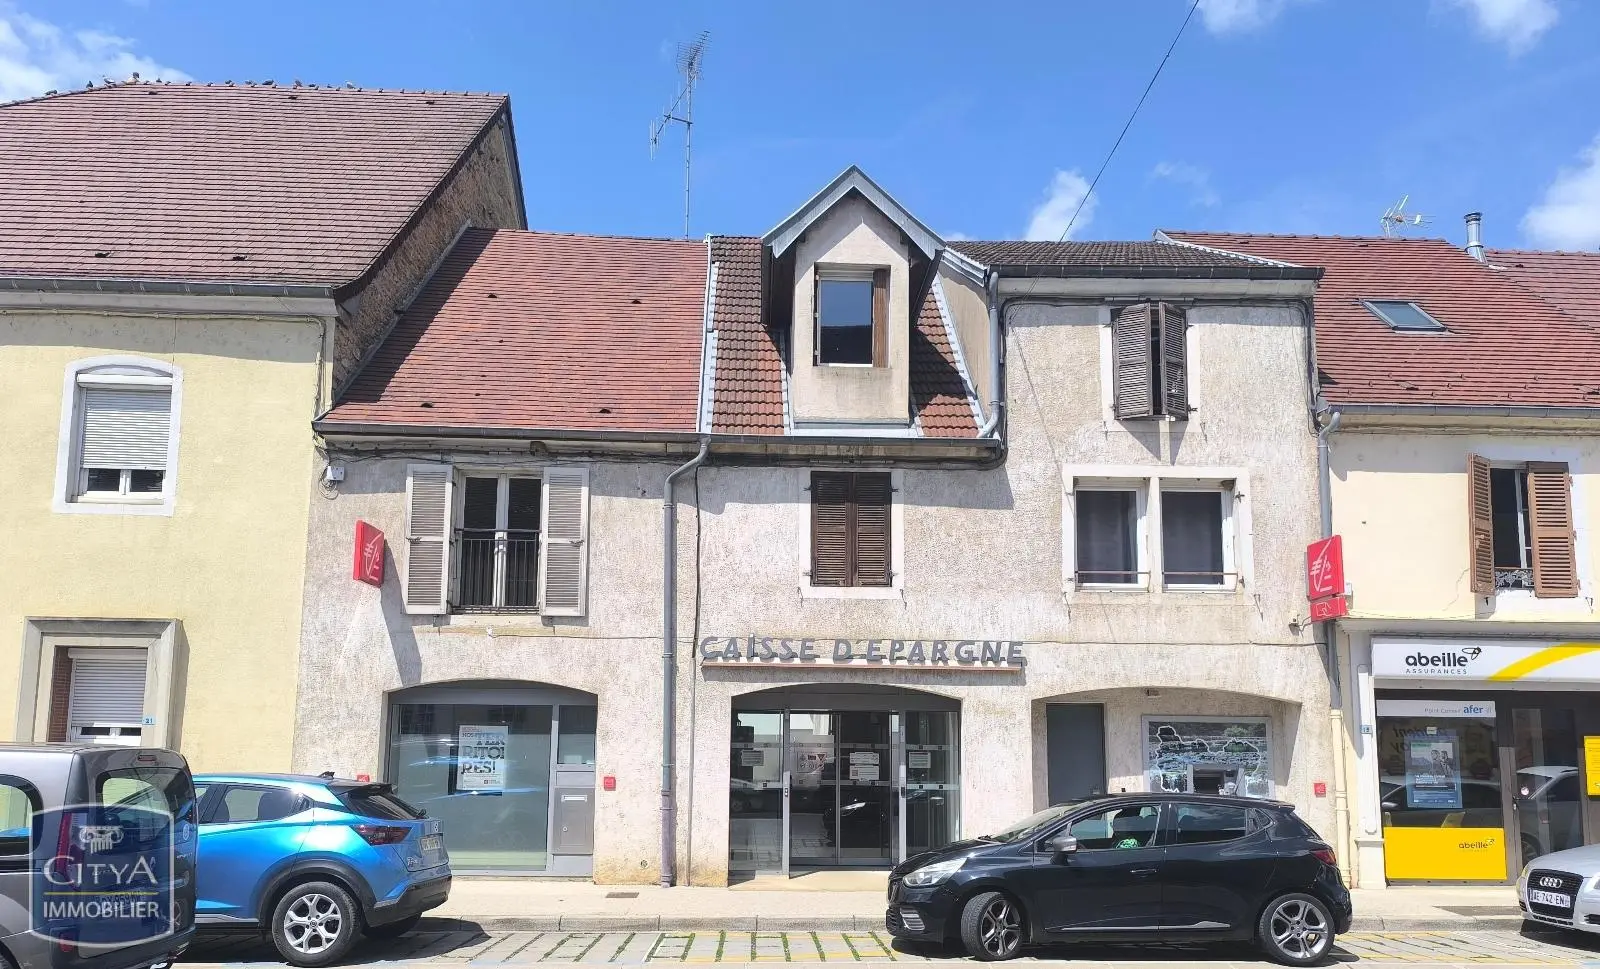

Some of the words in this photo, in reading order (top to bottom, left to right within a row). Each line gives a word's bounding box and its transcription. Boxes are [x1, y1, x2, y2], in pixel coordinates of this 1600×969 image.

[700, 635, 816, 660] CAISSE
[833, 638, 1026, 663] D'EPARGNE
[1405, 652, 1468, 667] abeille
[1463, 704, 1483, 714] afer
[1458, 841, 1489, 849] abeille
